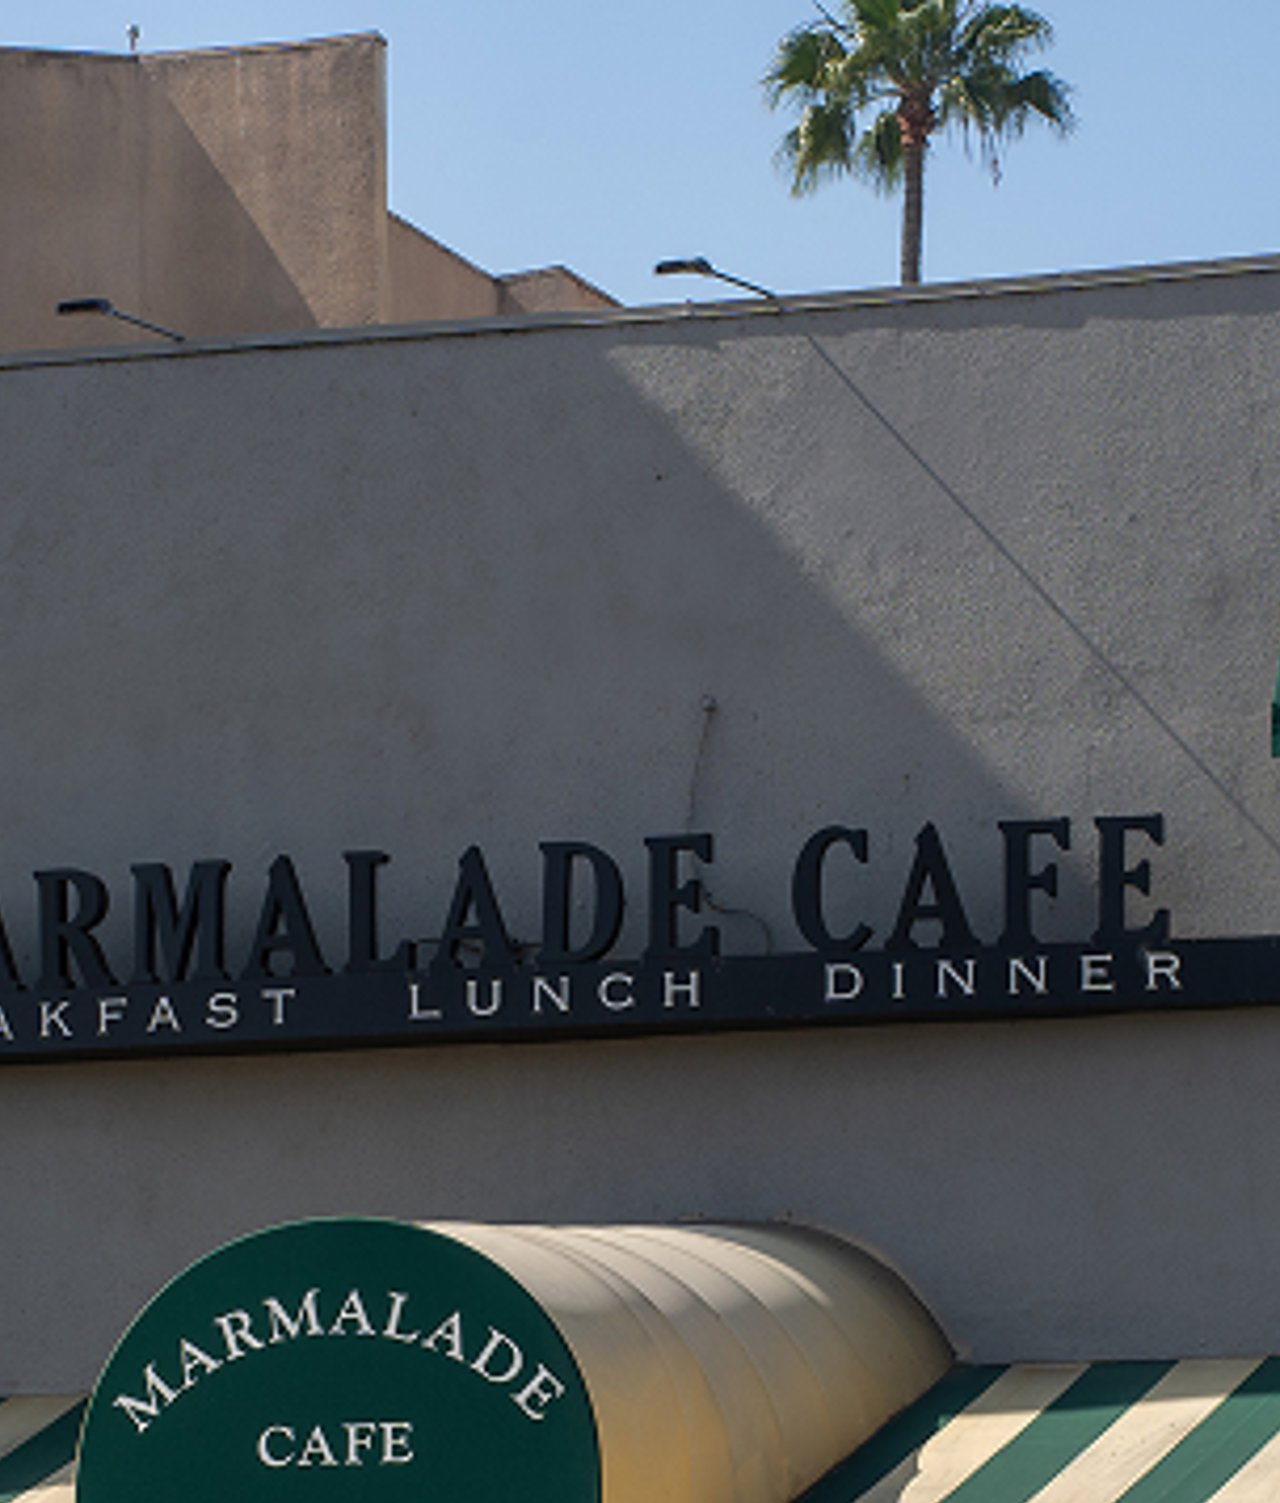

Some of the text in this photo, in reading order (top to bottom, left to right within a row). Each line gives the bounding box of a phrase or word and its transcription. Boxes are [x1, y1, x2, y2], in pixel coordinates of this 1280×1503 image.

[791, 813, 1172, 953] CAFE
[408, 971, 700, 1020] LUNCH
[825, 952, 1183, 1001] DINNER
[113, 1287, 566, 1433] MARMALADE
[257, 1421, 415, 1468] CAFE
